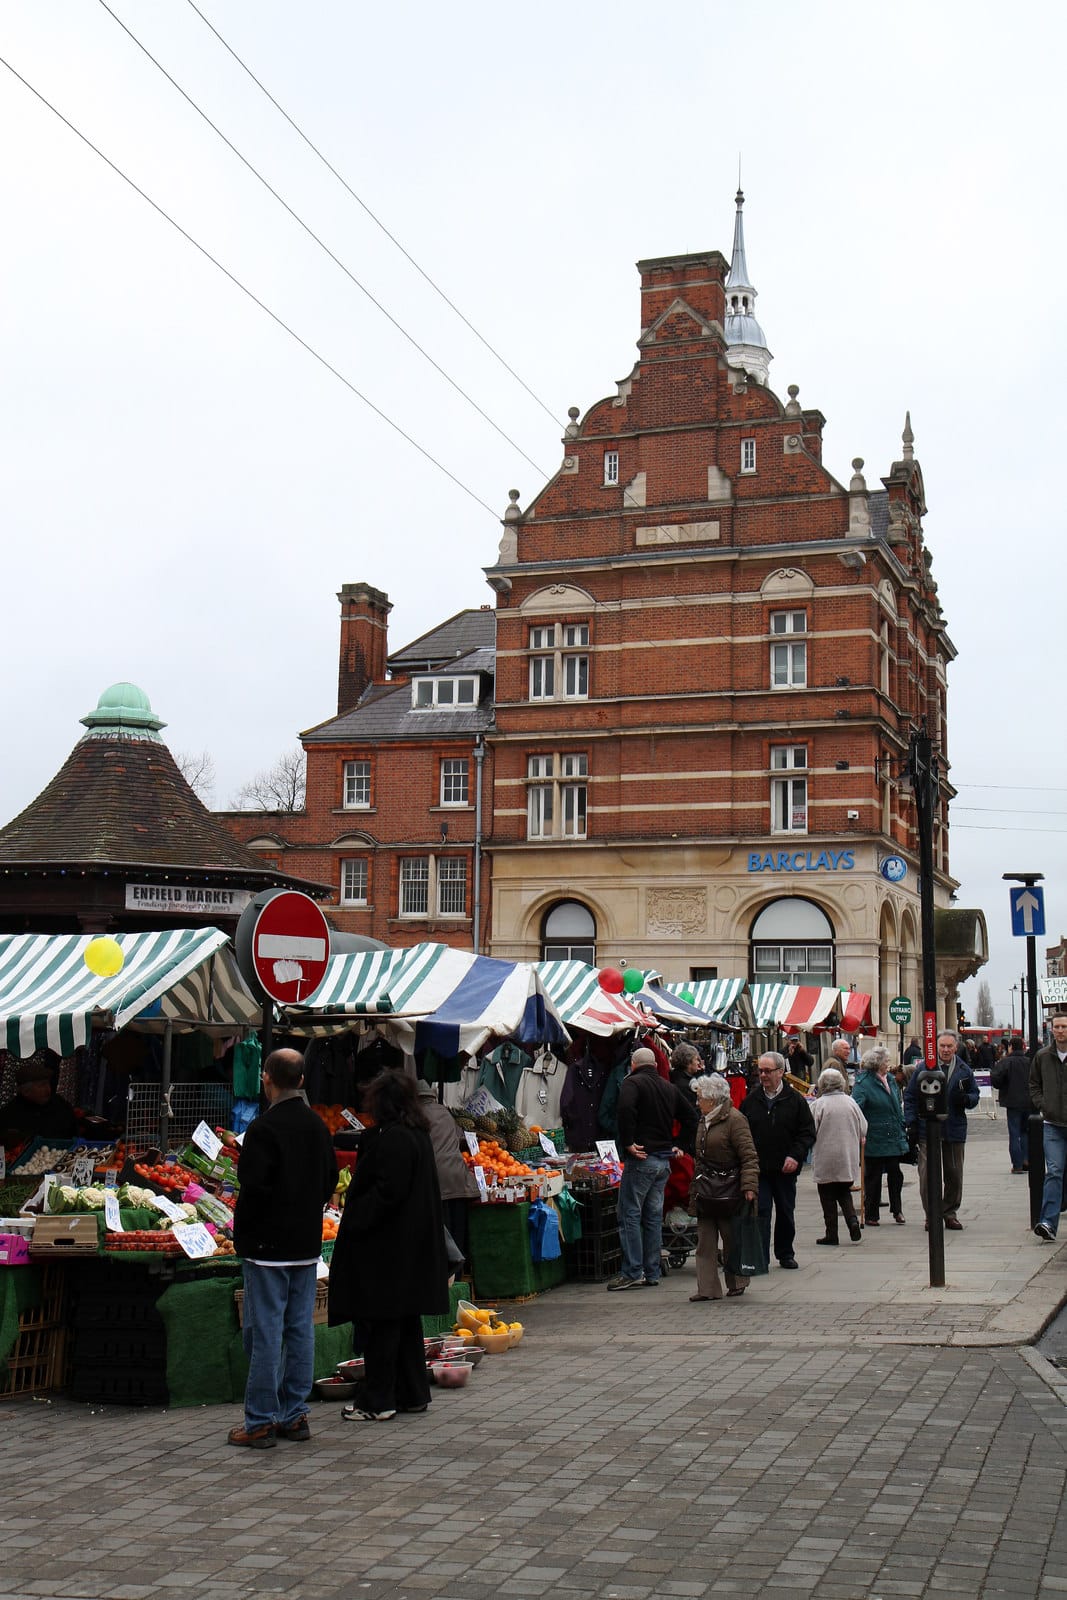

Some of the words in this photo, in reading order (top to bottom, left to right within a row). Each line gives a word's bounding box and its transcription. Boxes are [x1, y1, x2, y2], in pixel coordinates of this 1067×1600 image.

[646, 525, 711, 542] BANK
[747, 850, 855, 872] BARCLAYS
[133, 886, 180, 901] ENFIELD
[186, 890, 235, 904] MARKET
